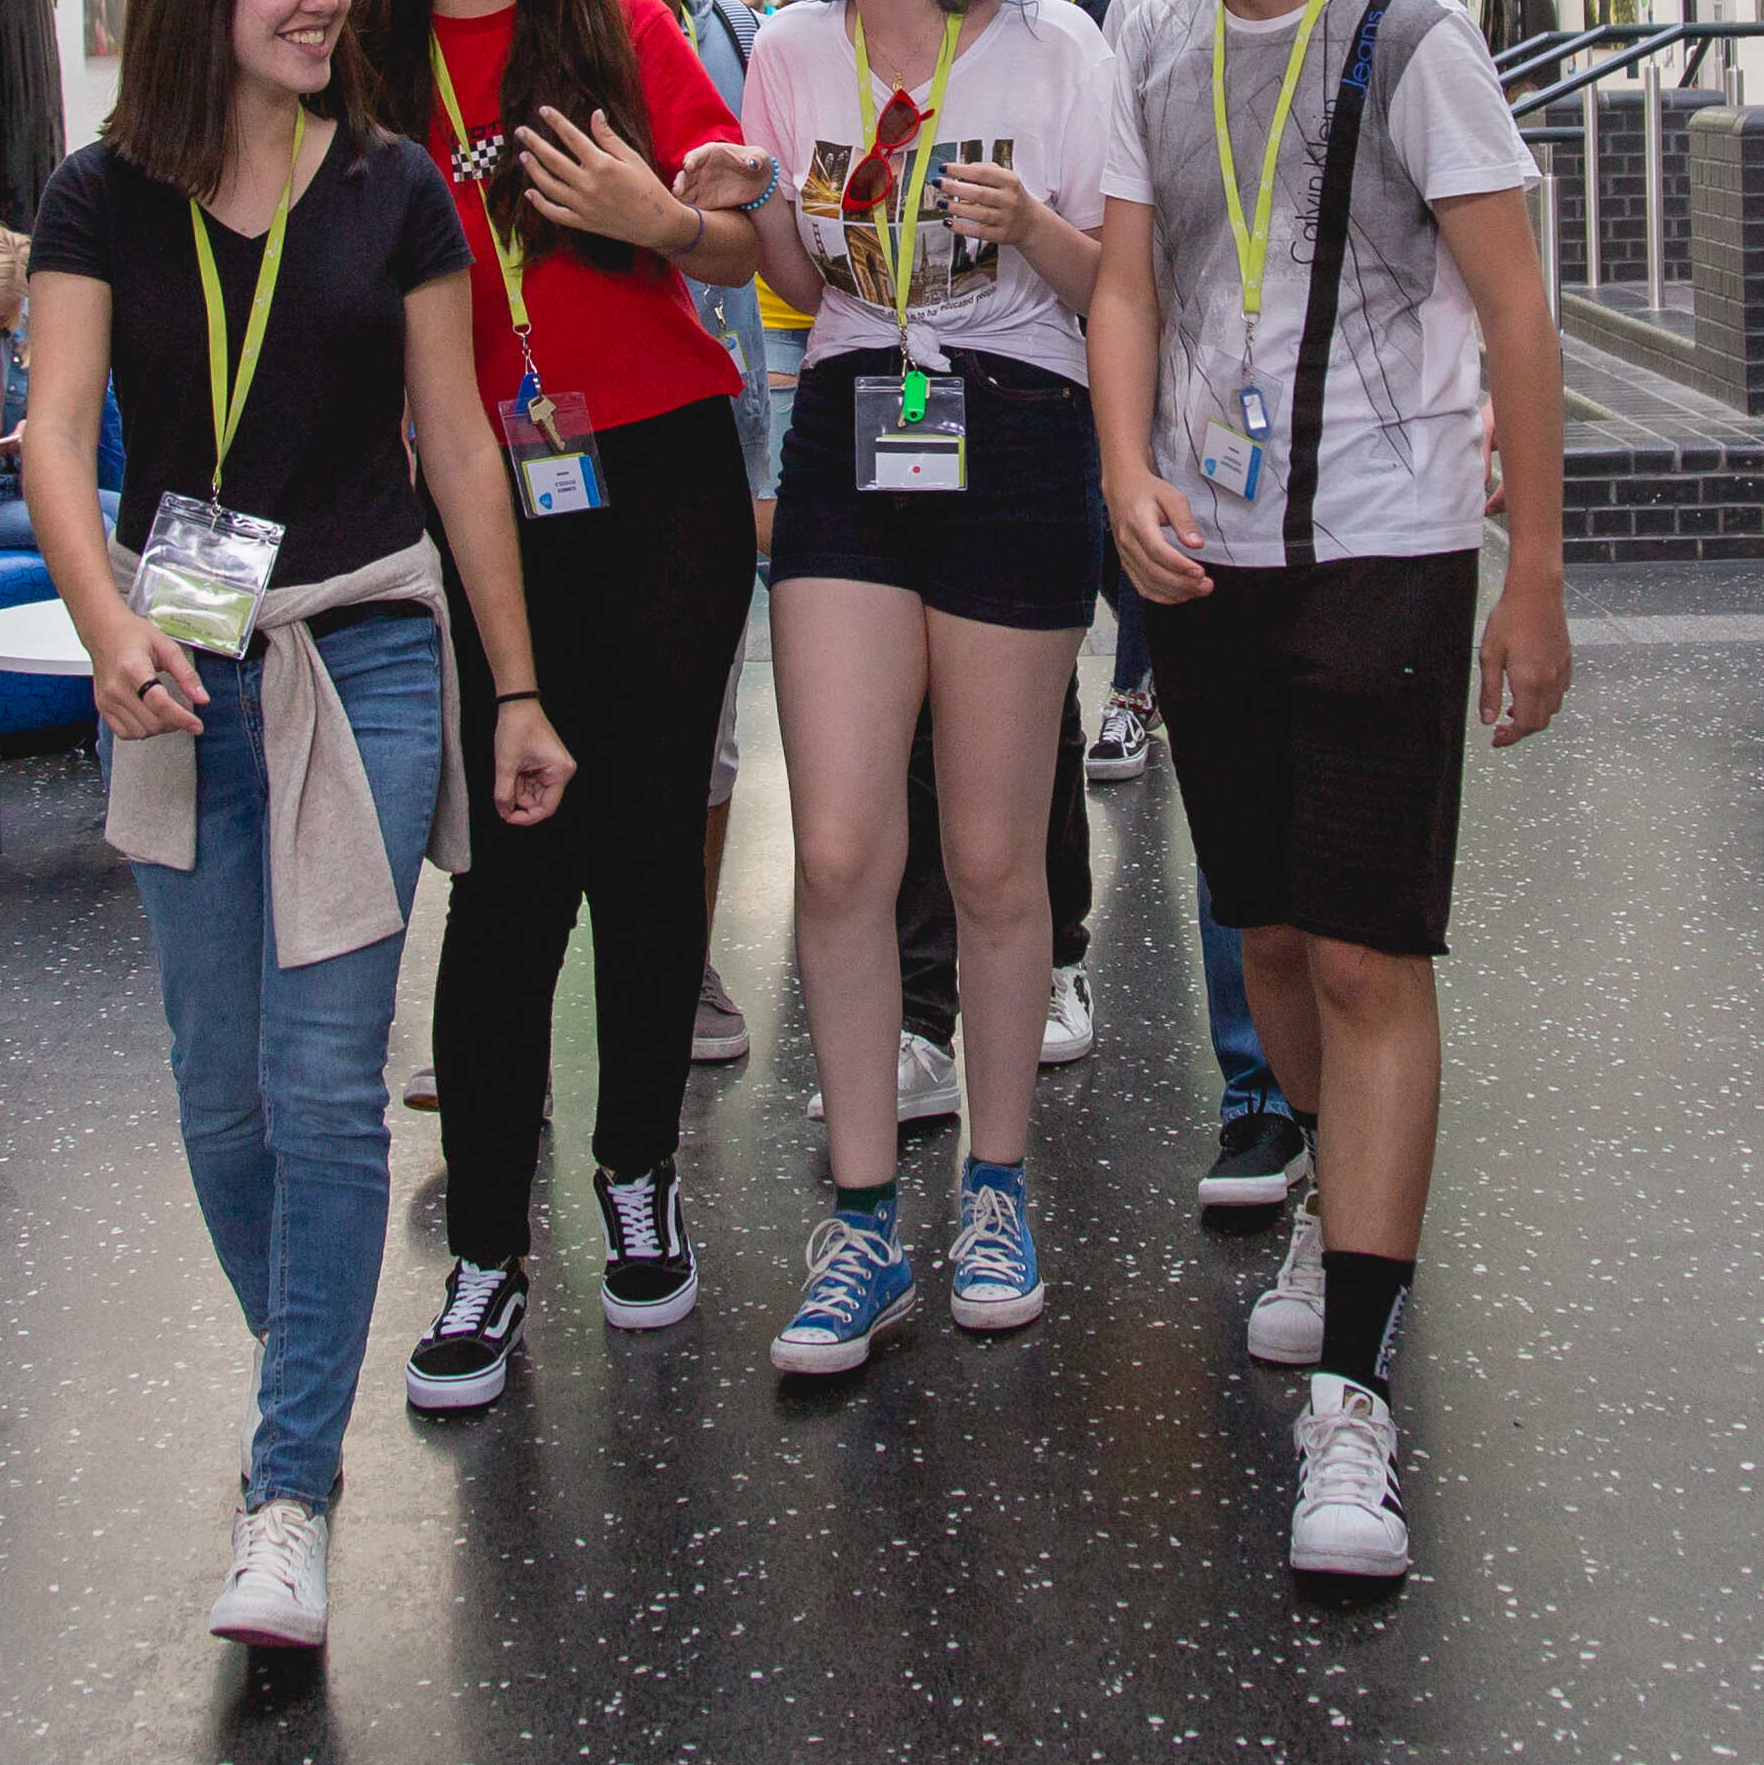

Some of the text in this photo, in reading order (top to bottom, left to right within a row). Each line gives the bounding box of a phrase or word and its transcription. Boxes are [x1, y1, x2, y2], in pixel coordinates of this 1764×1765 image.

[1340, 10, 1385, 99] Jeans
[1290, 98, 1338, 265] Calvin Klein
